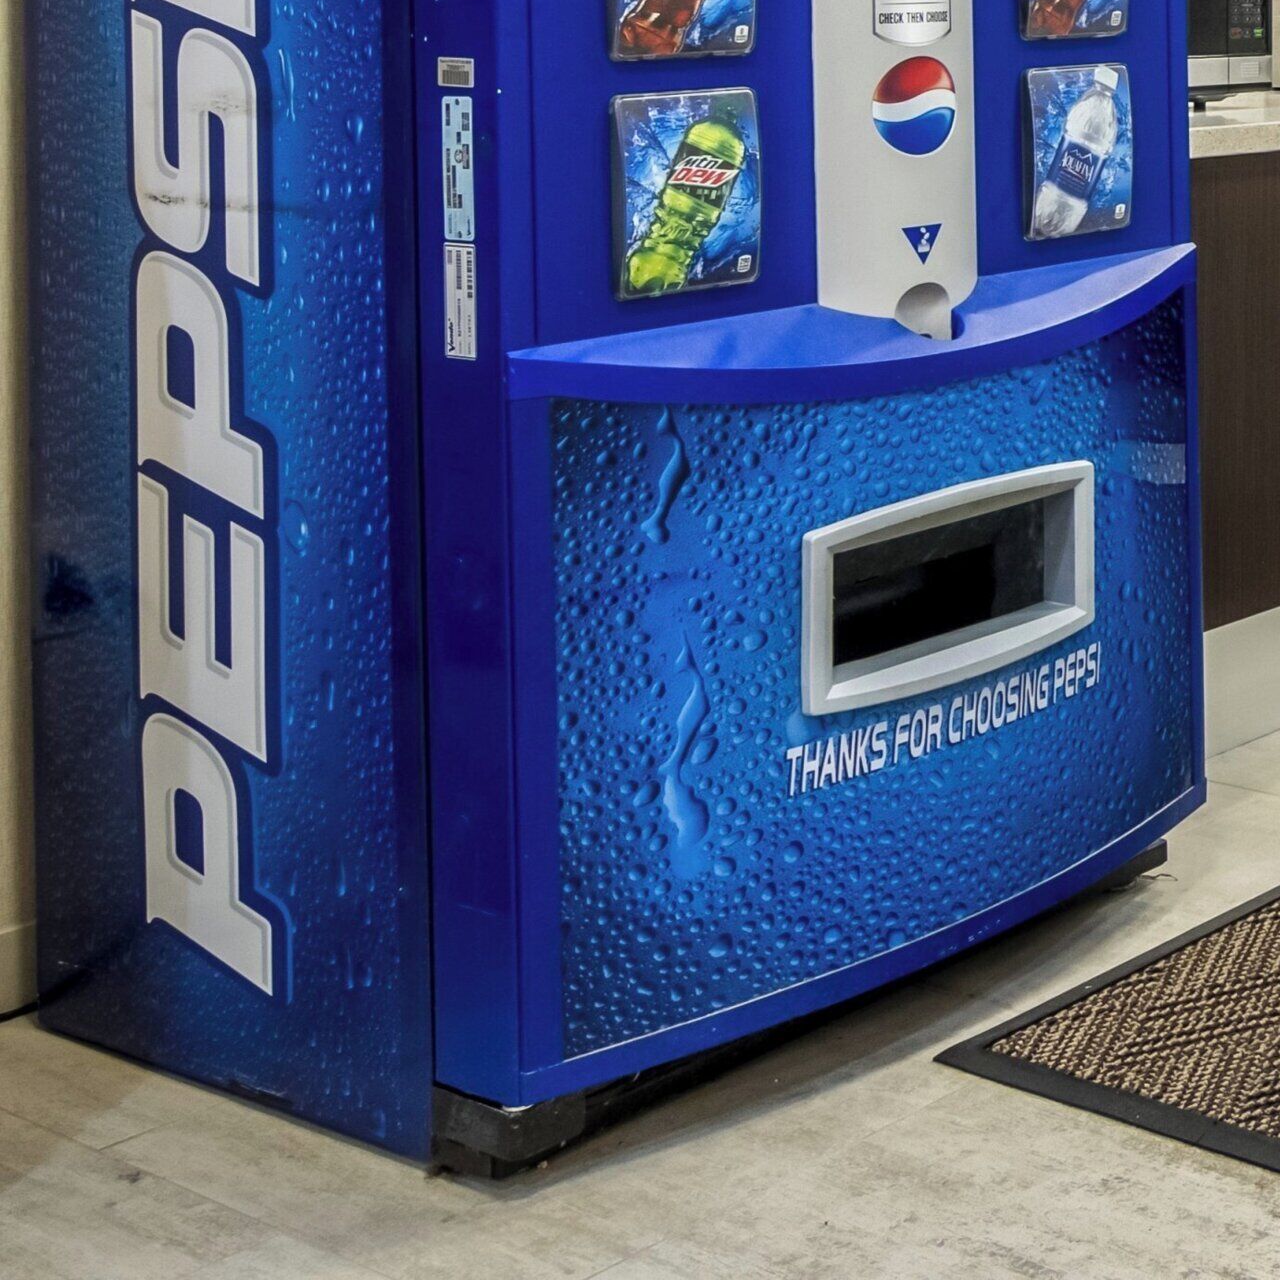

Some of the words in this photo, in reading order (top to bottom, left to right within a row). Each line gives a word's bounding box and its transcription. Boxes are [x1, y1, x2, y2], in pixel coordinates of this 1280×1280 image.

[878, 12, 904, 24] CHECK
[906, 12, 924, 24] THEN
[926, 10, 948, 23] CHOOSE
[786, 721, 887, 796] THANKS
[894, 704, 942, 764] FOR
[948, 664, 1049, 744] CHOOSING
[1053, 641, 1101, 704] PEPSI
